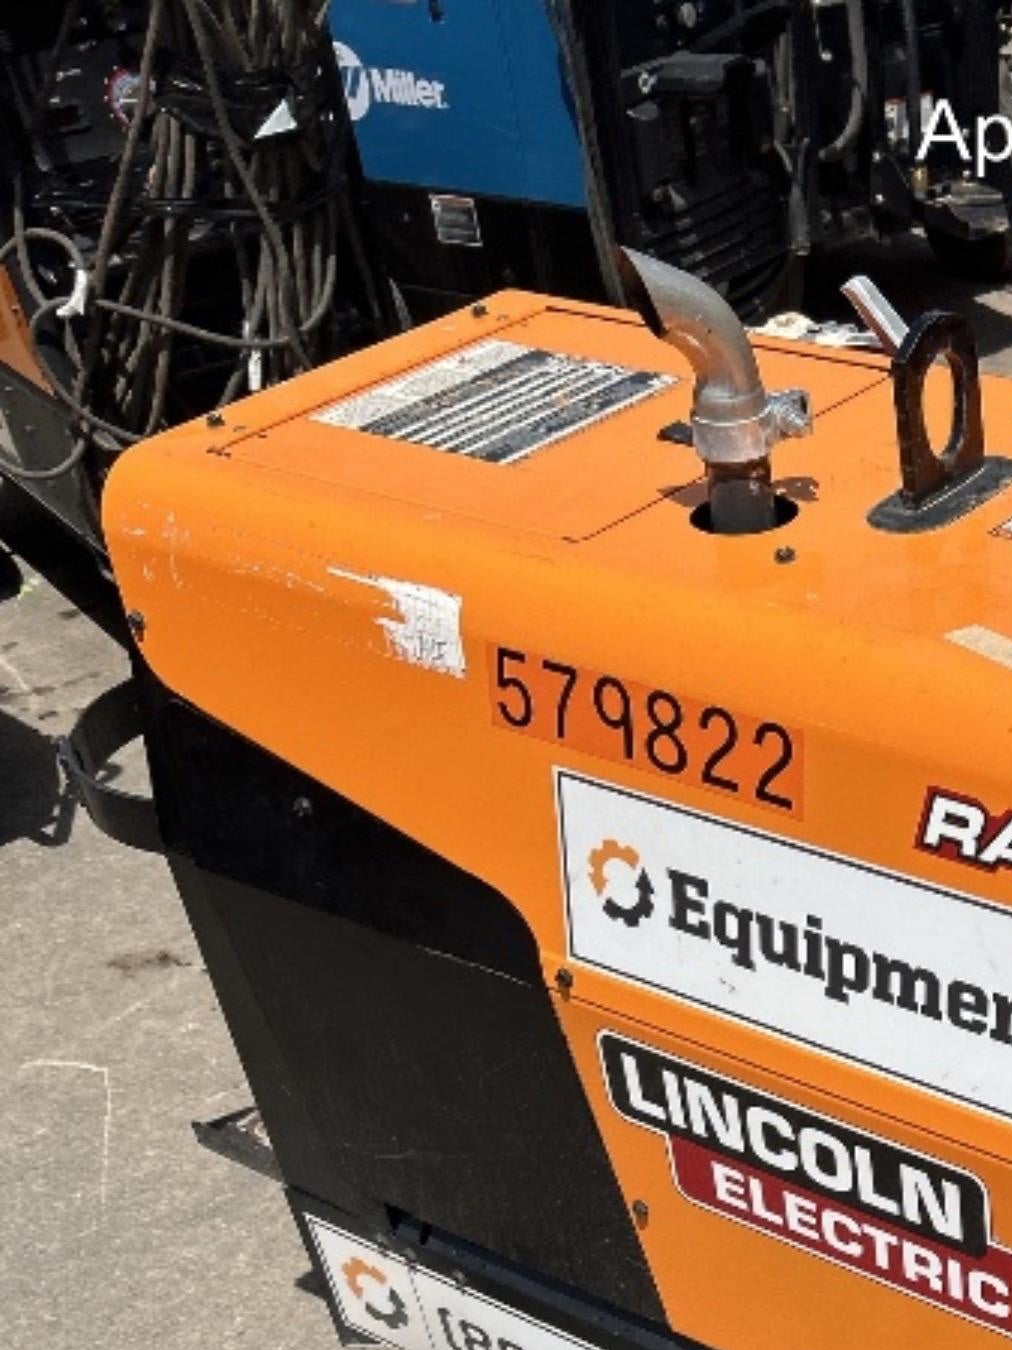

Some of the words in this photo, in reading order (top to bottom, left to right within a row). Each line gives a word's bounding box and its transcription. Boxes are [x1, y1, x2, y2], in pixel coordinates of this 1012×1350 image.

[369, 67, 444, 108] Miller
[496, 646, 793, 810] 579822
[620, 1053, 964, 1242] LINCOLN
[711, 1161, 1012, 1320] ELECTRIC
